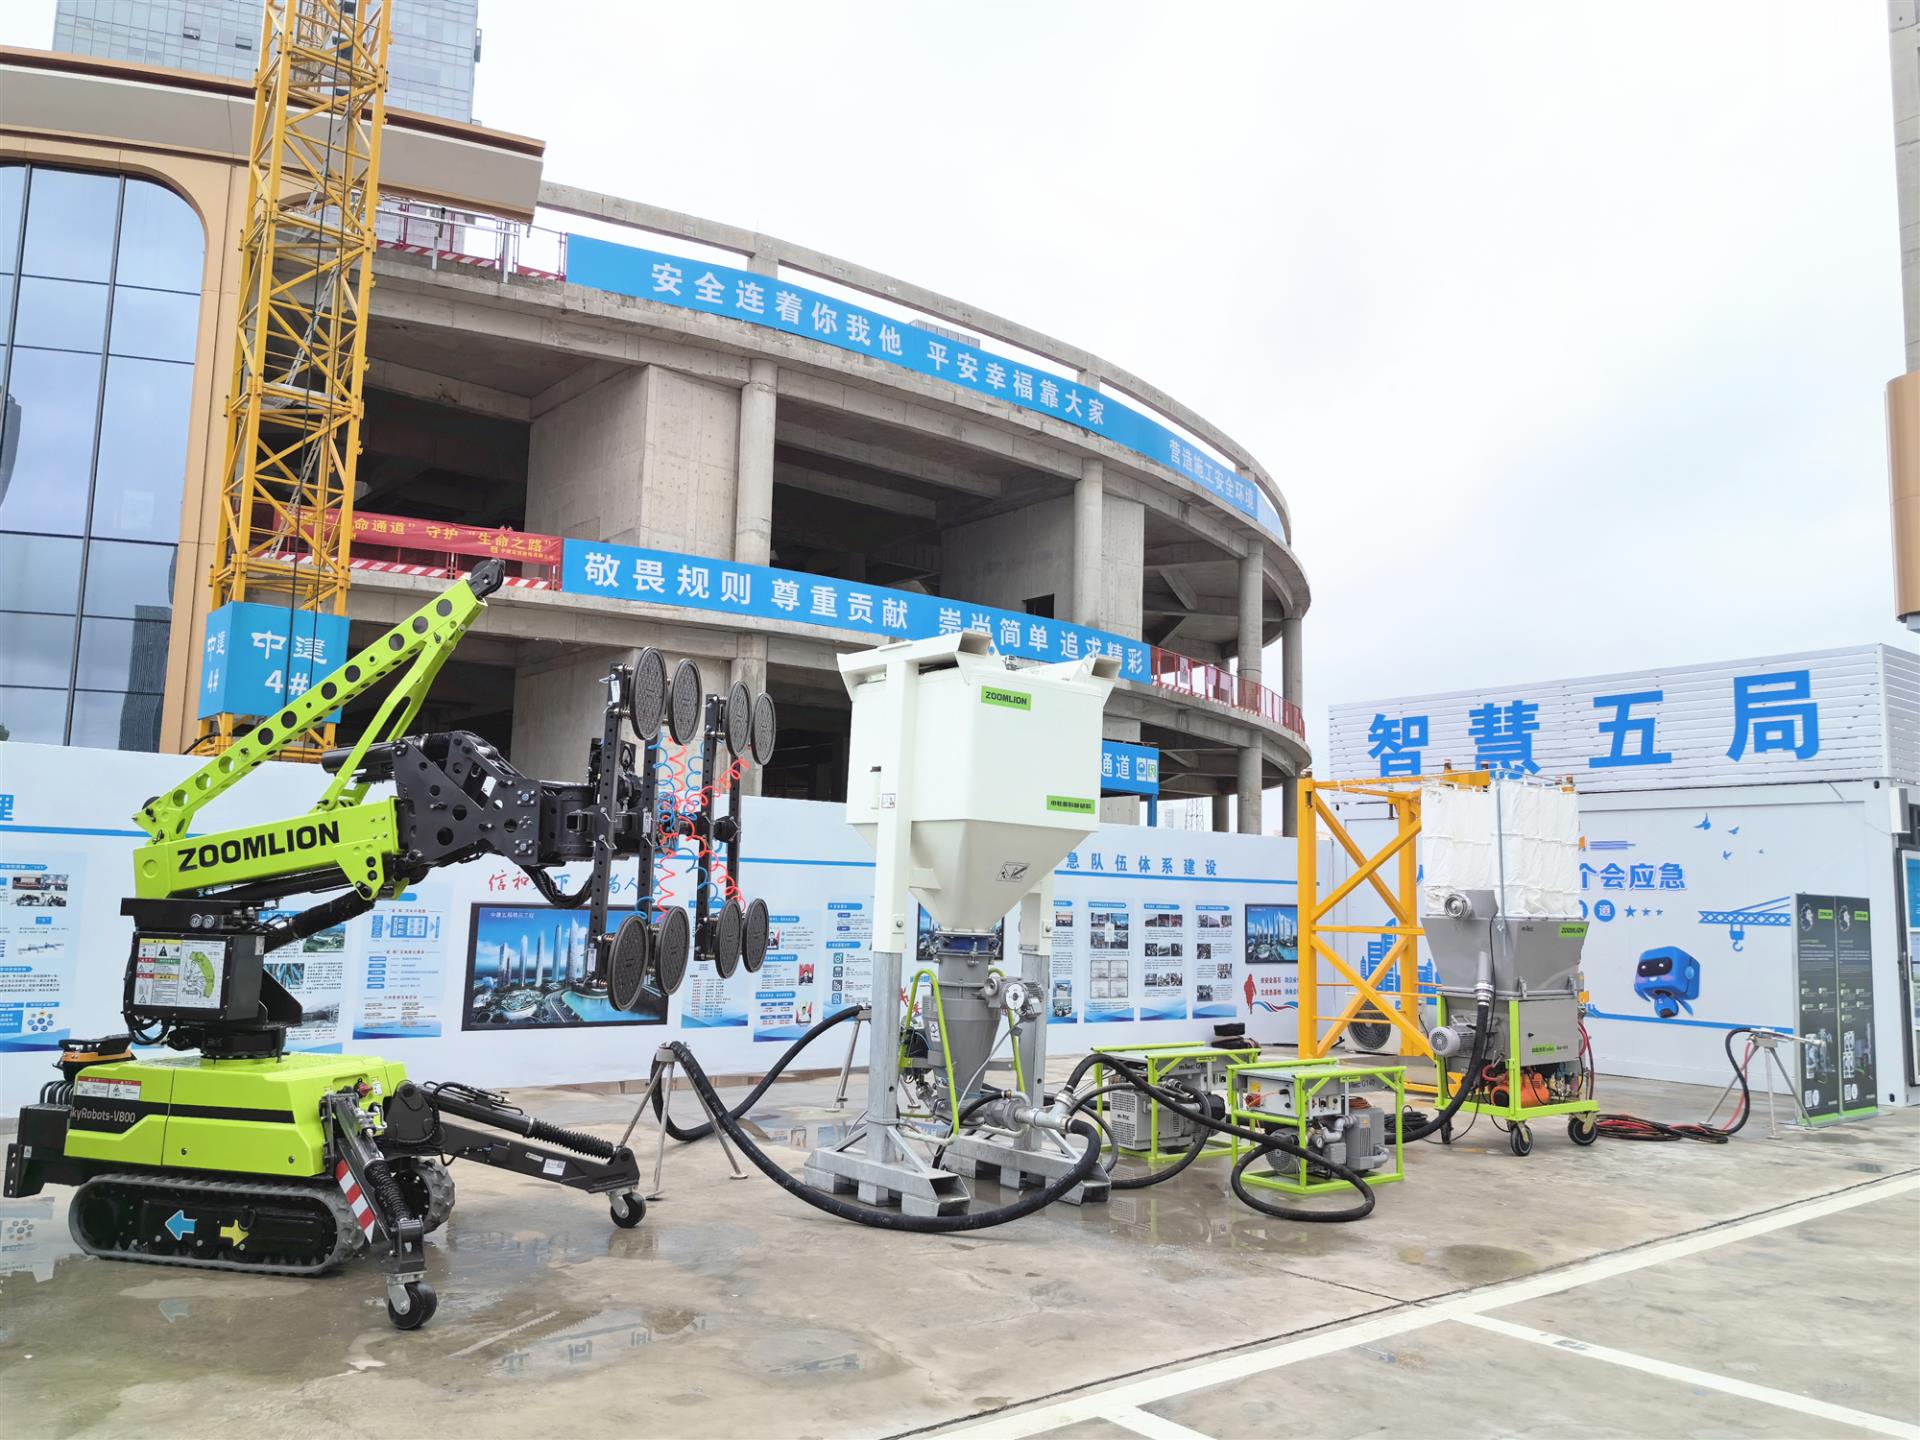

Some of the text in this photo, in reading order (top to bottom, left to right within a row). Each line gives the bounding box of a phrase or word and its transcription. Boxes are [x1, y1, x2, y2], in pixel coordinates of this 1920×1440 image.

[652, 263, 1104, 425] 安全连着你我他 平安幸福靠大家
[1170, 440, 1254, 510] 营造施工安全环境
[584, 552, 1143, 674] 敬畏规则 尊重贡献 崇尚简单 追求精彩
[251, 630, 328, 665] 中建
[207, 668, 219, 694] 4#
[264, 669, 309, 696] 4#
[985, 691, 1028, 705] ZOOMLION
[1367, 670, 1820, 781] 智慧五局
[1101, 752, 1131, 780] 通道
[177, 820, 341, 872] ZOOMLION
[1066, 851, 1217, 876] 急队伍体系建设
[488, 869, 571, 892] 信和下
